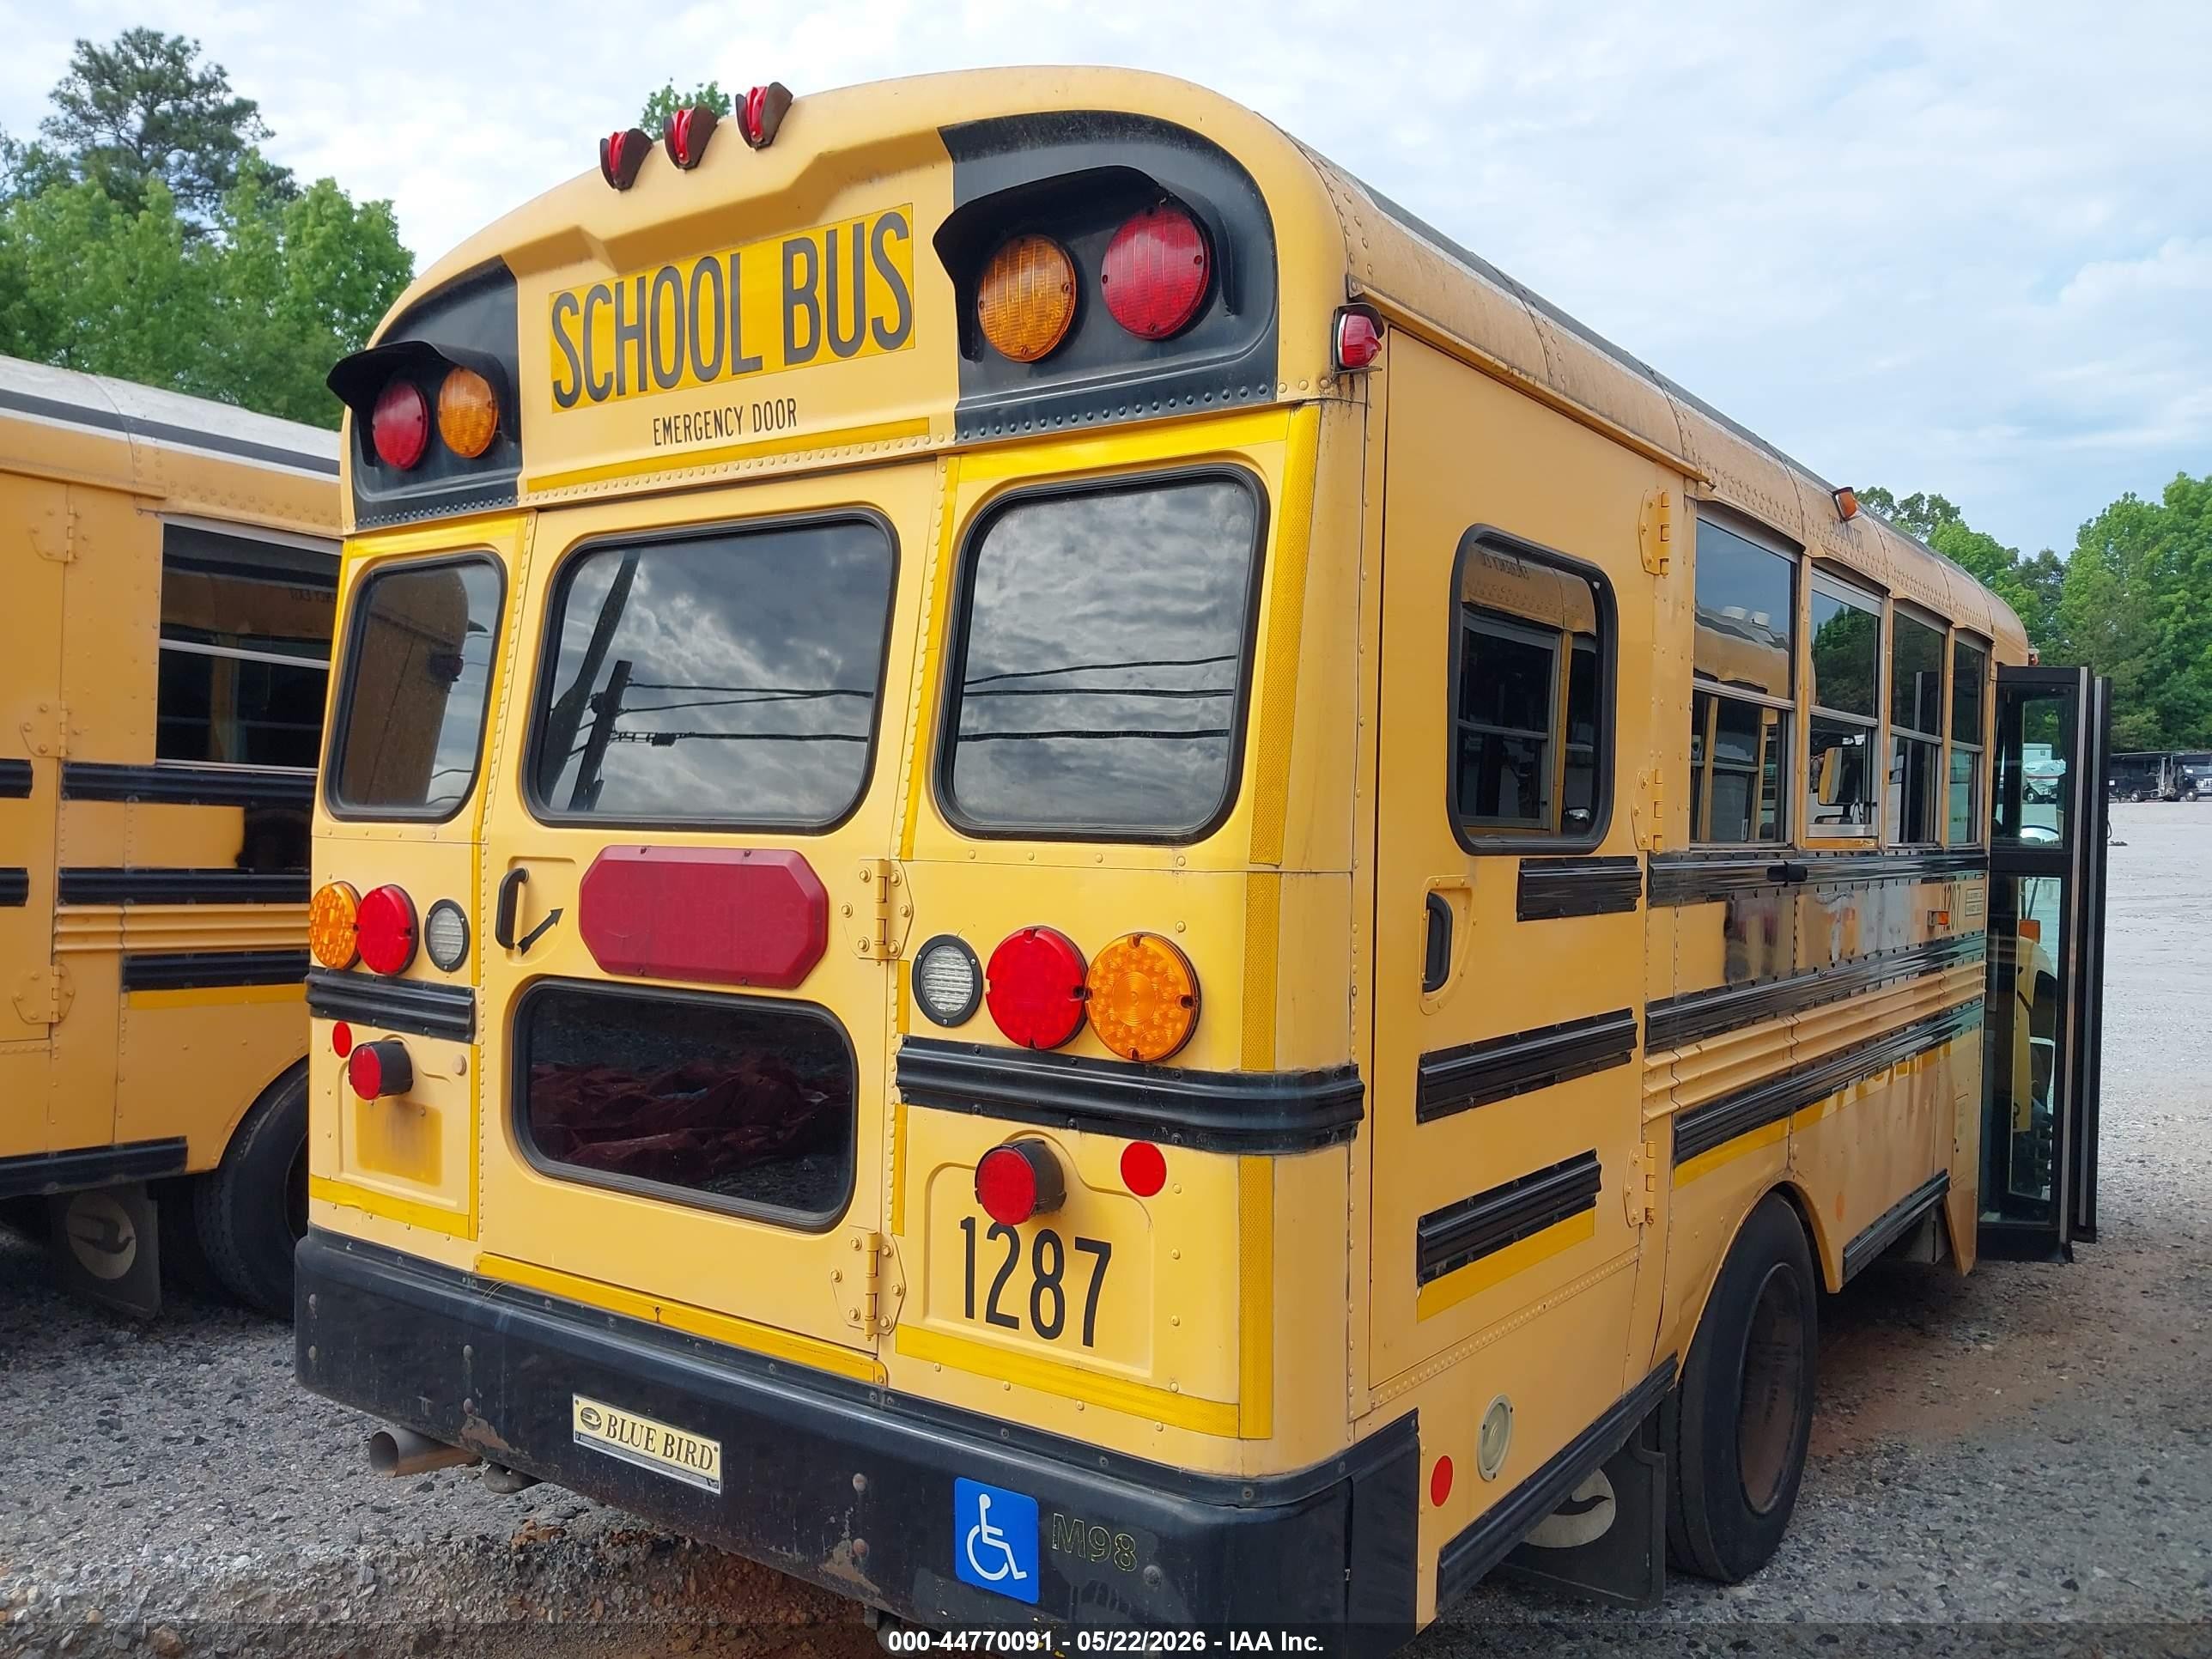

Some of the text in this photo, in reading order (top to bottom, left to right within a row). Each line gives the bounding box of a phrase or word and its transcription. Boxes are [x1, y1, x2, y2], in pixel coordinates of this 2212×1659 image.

[551, 211, 913, 409] SCHOOL BUS
[653, 398, 797, 447] EMERGENCY DOOR
[1942, 884, 1961, 932] 1287
[960, 1216, 1112, 1348] 1287
[605, 1413, 714, 1470] BLUE BIRD
[1052, 1512, 1138, 1572] M98
